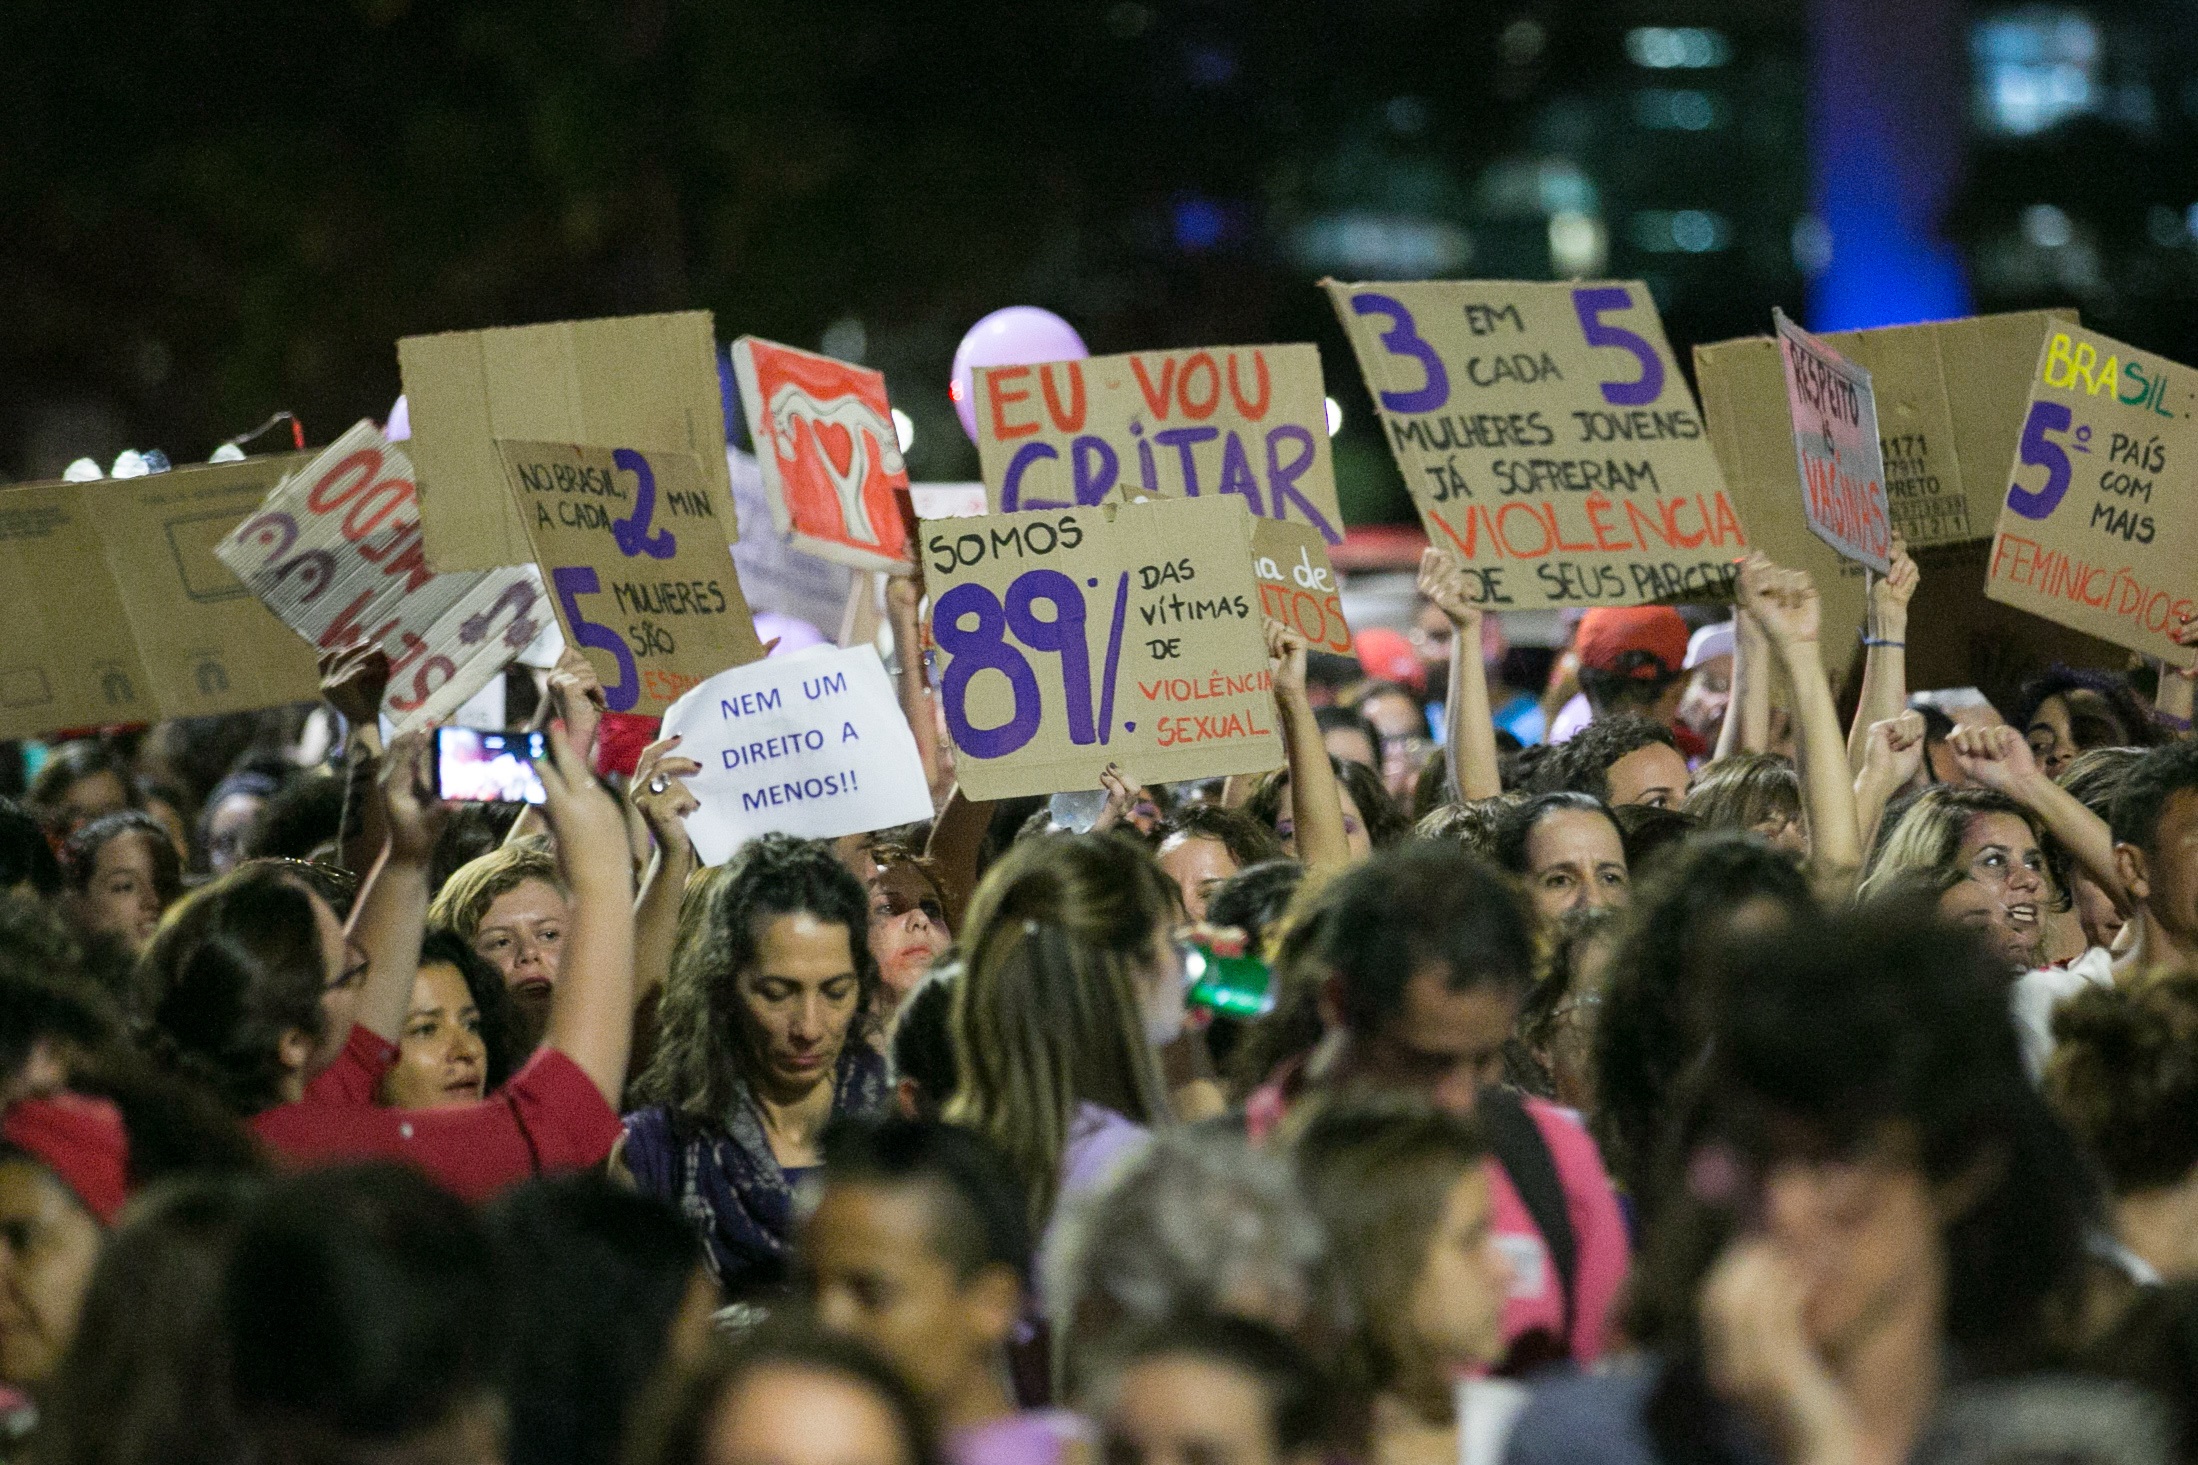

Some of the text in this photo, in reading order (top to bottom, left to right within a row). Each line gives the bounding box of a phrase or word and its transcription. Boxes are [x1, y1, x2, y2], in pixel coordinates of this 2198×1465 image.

[1351, 288, 1665, 414] 3 EM CADA 5
[985, 350, 1272, 441] EU VOU
[2043, 333, 2175, 419] BRASIL
[1390, 410, 1702, 452] MULHERES JOVENS
[2110, 432, 2165, 475] PAÍS
[1424, 456, 1660, 501] JÁ SOFRERAM
[2100, 470, 2153, 503] COM
[537, 448, 713, 560] A CADA 2 MIN
[1429, 488, 1747, 560] VIOLÊNCIA
[2090, 501, 2156, 544] MAIS
[929, 516, 1083, 574] SOMOS
[1138, 558, 1195, 593] DAS
[1293, 544, 1335, 592] de
[1537, 561, 1625, 600] SEUS
[552, 566, 641, 713] 5
[612, 581, 726, 616] MULHERES
[629, 621, 675, 658] SÃO
[1258, 582, 1353, 654] ITOS
[1146, 638, 1181, 660] DE
[720, 672, 847, 720] NEM UM
[1137, 668, 1272, 702] VIOLÊNCIA
[722, 721, 859, 769] DIREITO A
[1157, 709, 1271, 747] SEXUAL
[742, 769, 858, 812] MENOS!!
